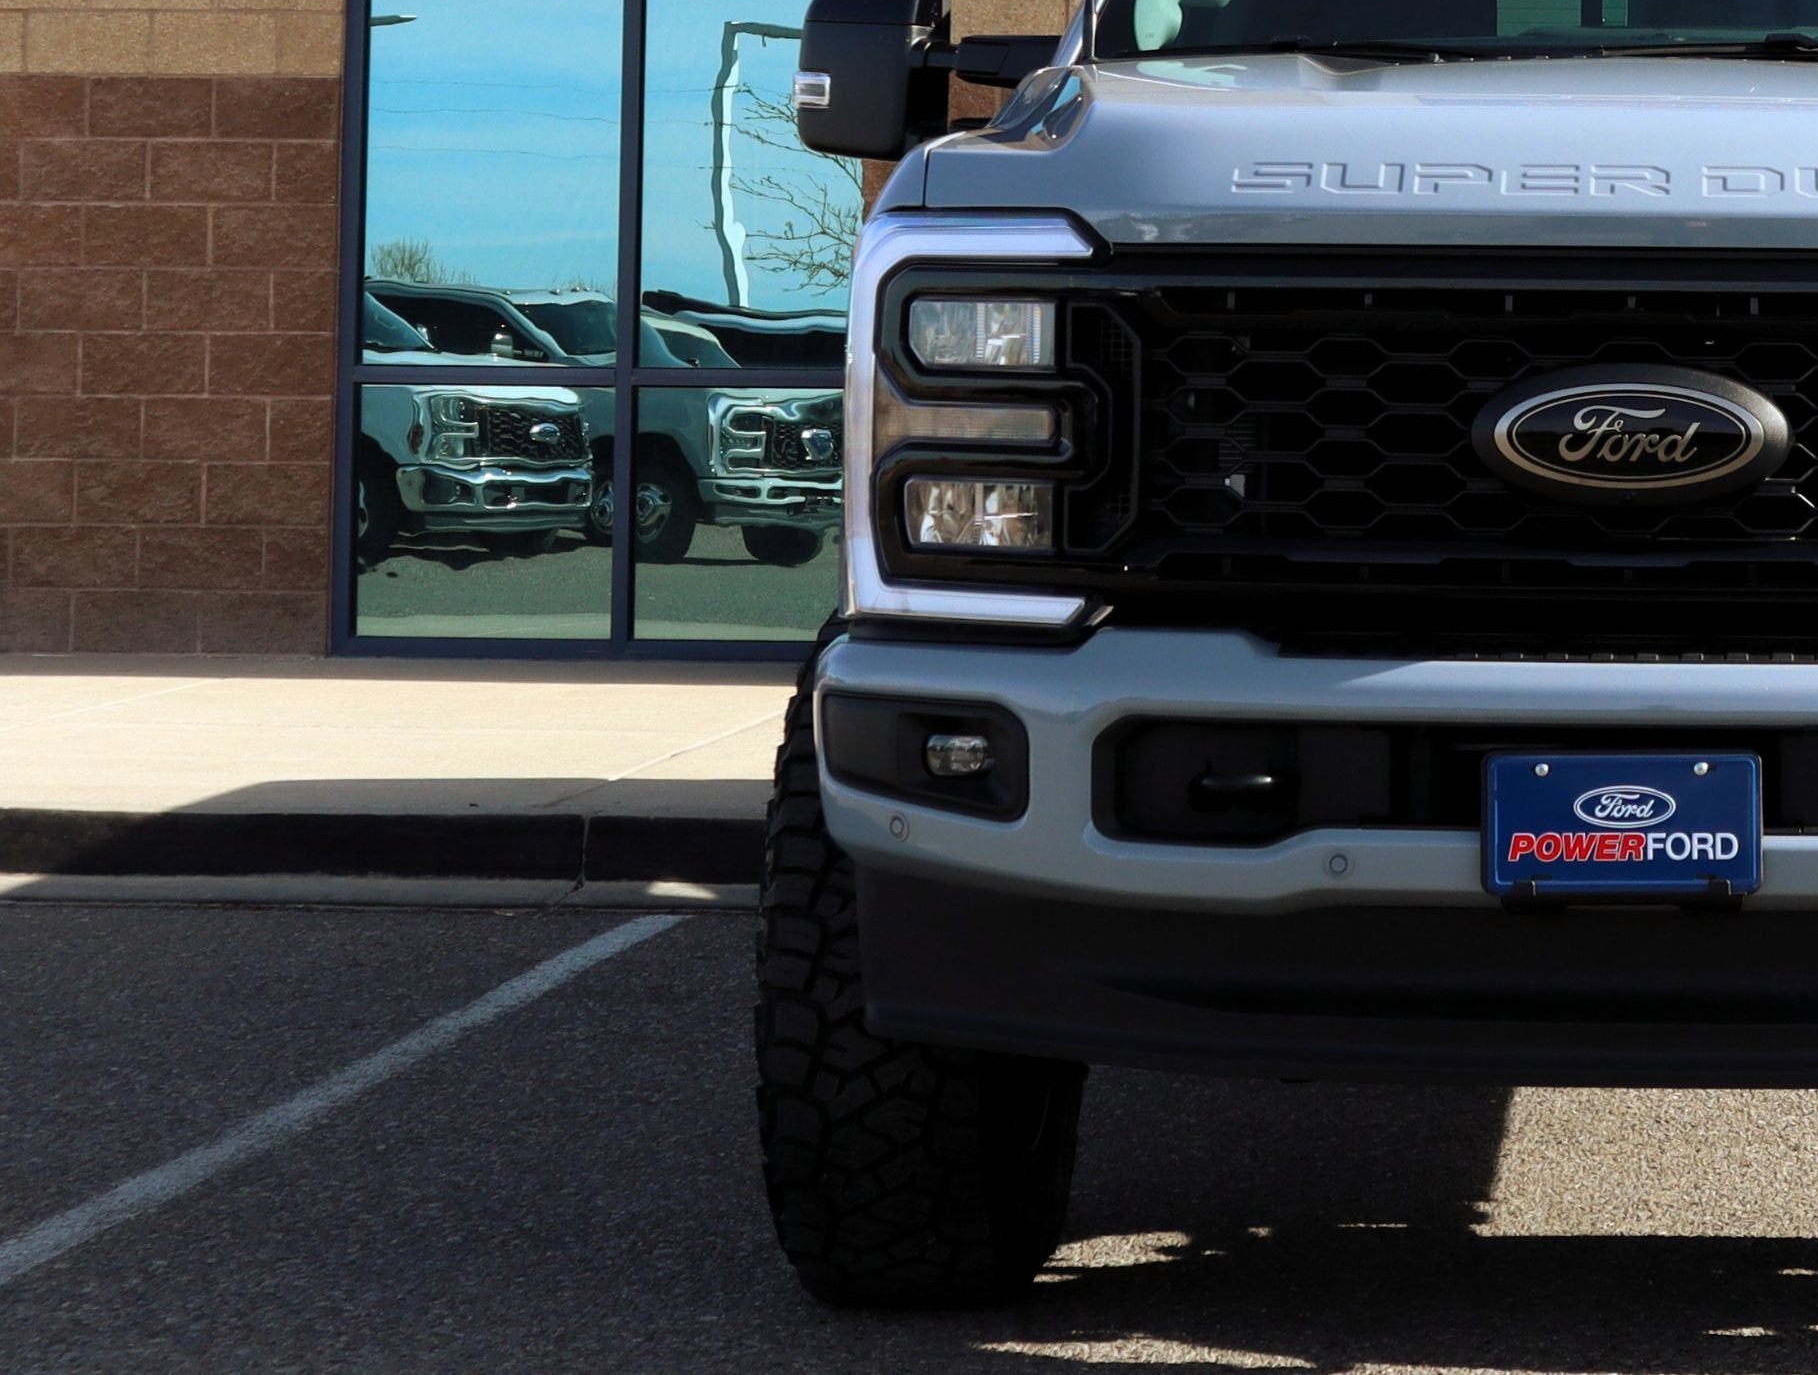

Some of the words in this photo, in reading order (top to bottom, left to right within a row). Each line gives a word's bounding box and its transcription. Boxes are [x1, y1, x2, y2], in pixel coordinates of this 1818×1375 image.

[1231, 161, 1671, 197] SUPER
[1558, 404, 1701, 463] Ford
[1594, 793, 1654, 819] Ford
[1508, 831, 1739, 862] POWERFORD
